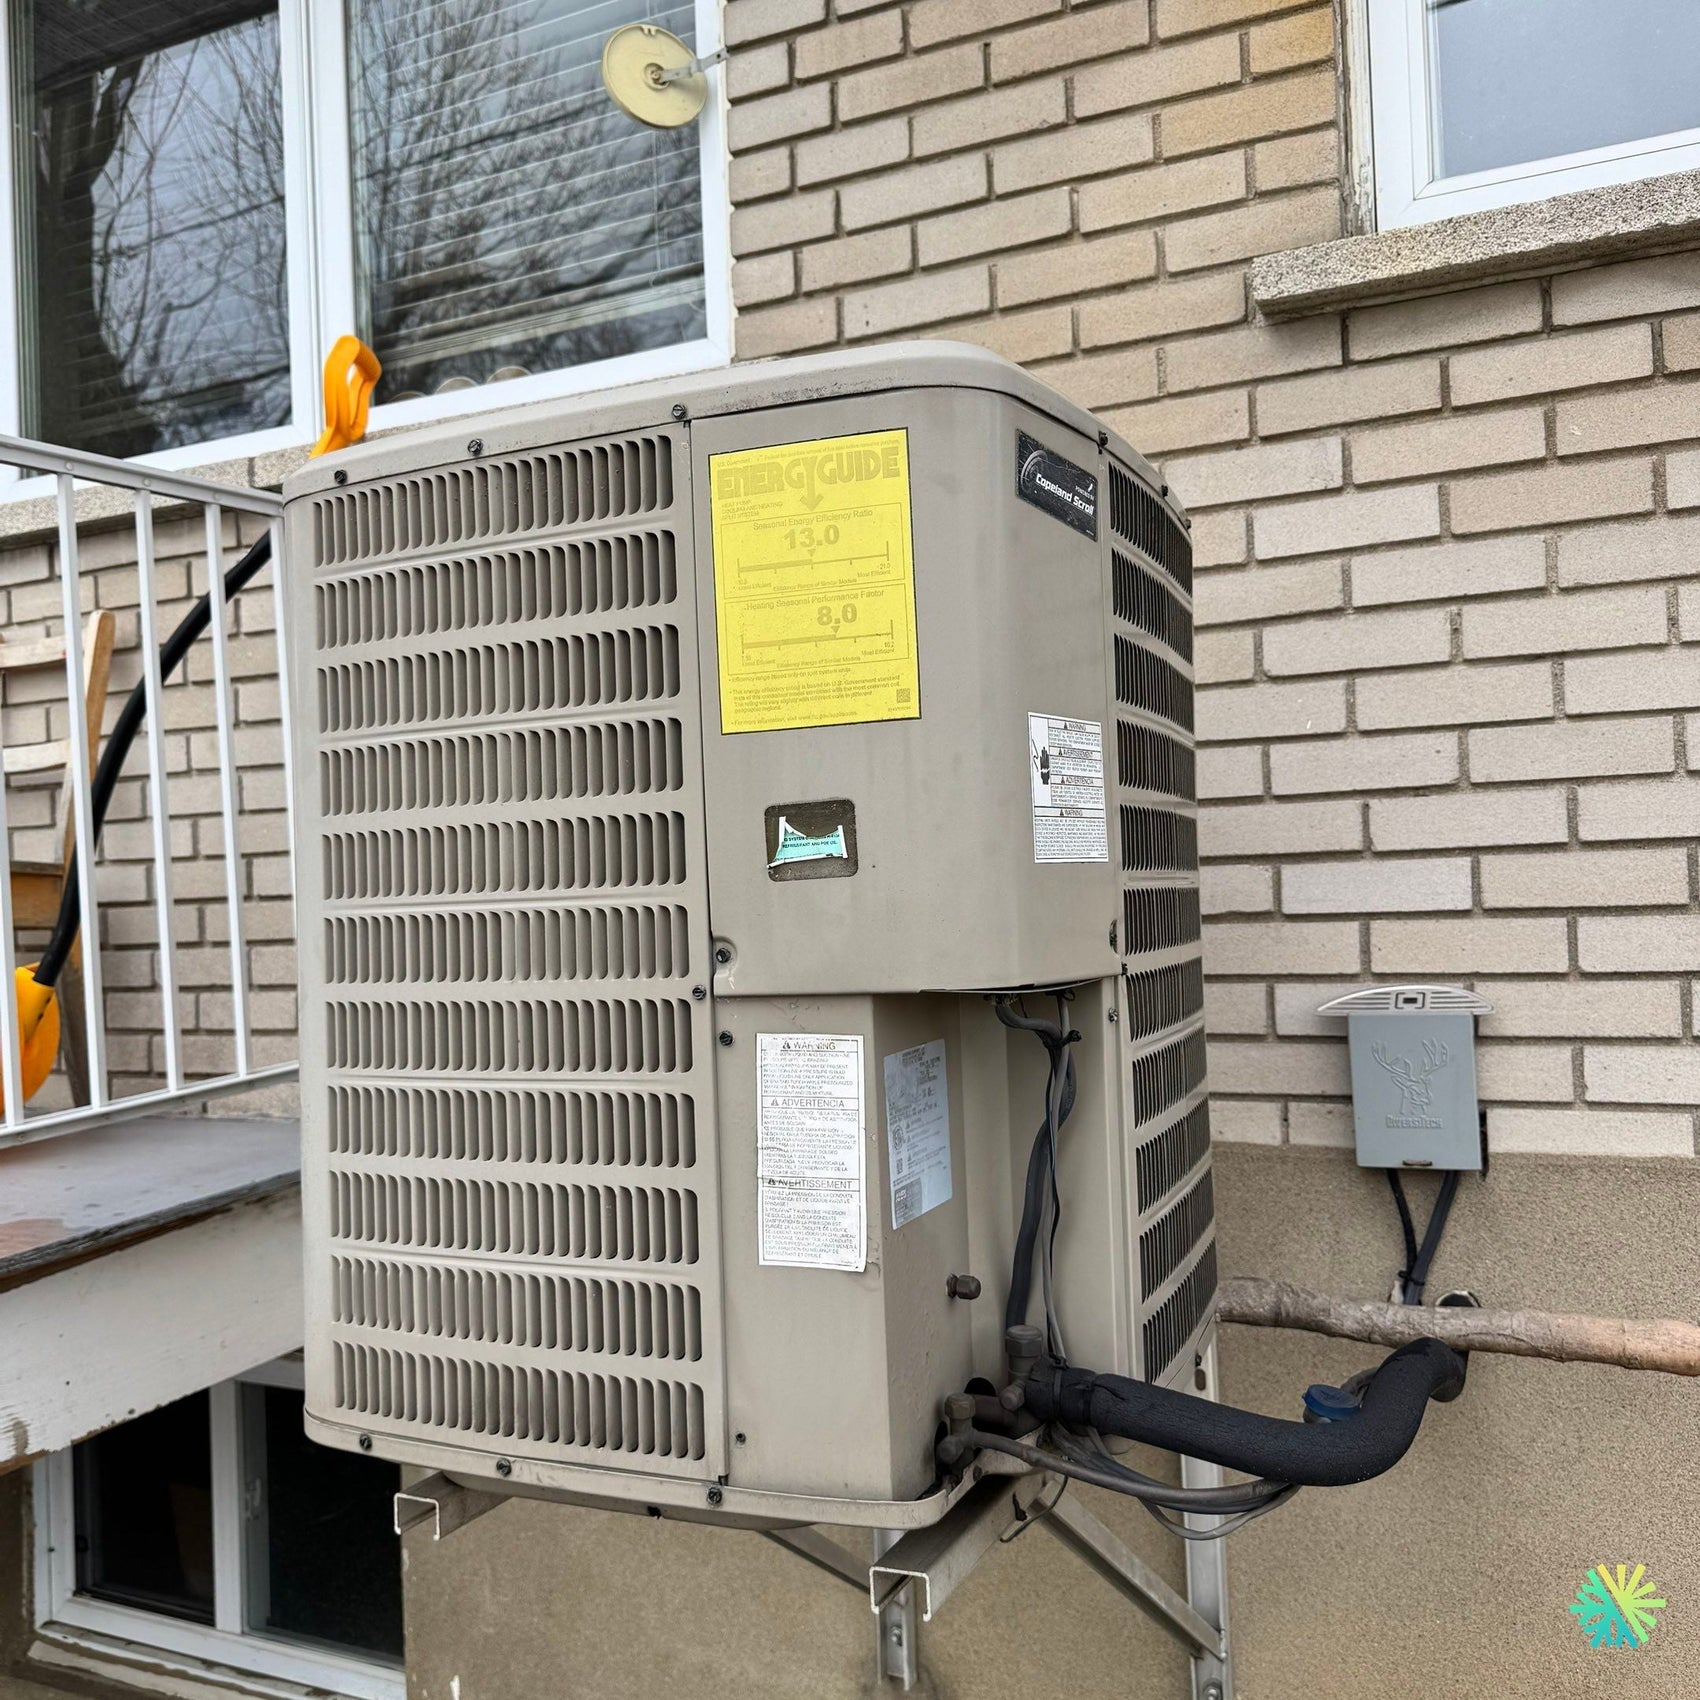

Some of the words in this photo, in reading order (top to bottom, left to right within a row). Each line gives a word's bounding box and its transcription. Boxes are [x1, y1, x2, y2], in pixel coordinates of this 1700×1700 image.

[717, 446, 901, 500] ENERGYGUIDE
[1036, 473, 1072, 502] Copeland
[1073, 495, 1094, 516] Scroll
[753, 519, 786, 531] Seasonal
[788, 516, 816, 526] Energy
[816, 512, 851, 524] Efficiency
[852, 509, 873, 518] Ratio
[784, 524, 840, 550] 13.0
[746, 602, 775, 610] Heating
[776, 597, 810, 608] Seasonal
[812, 592, 859, 604] Performance
[816, 603, 858, 626] 8.0
[782, 1098, 845, 1108] ADVERTENCIA
[777, 1178, 852, 1189] AVERTISSEMENT
